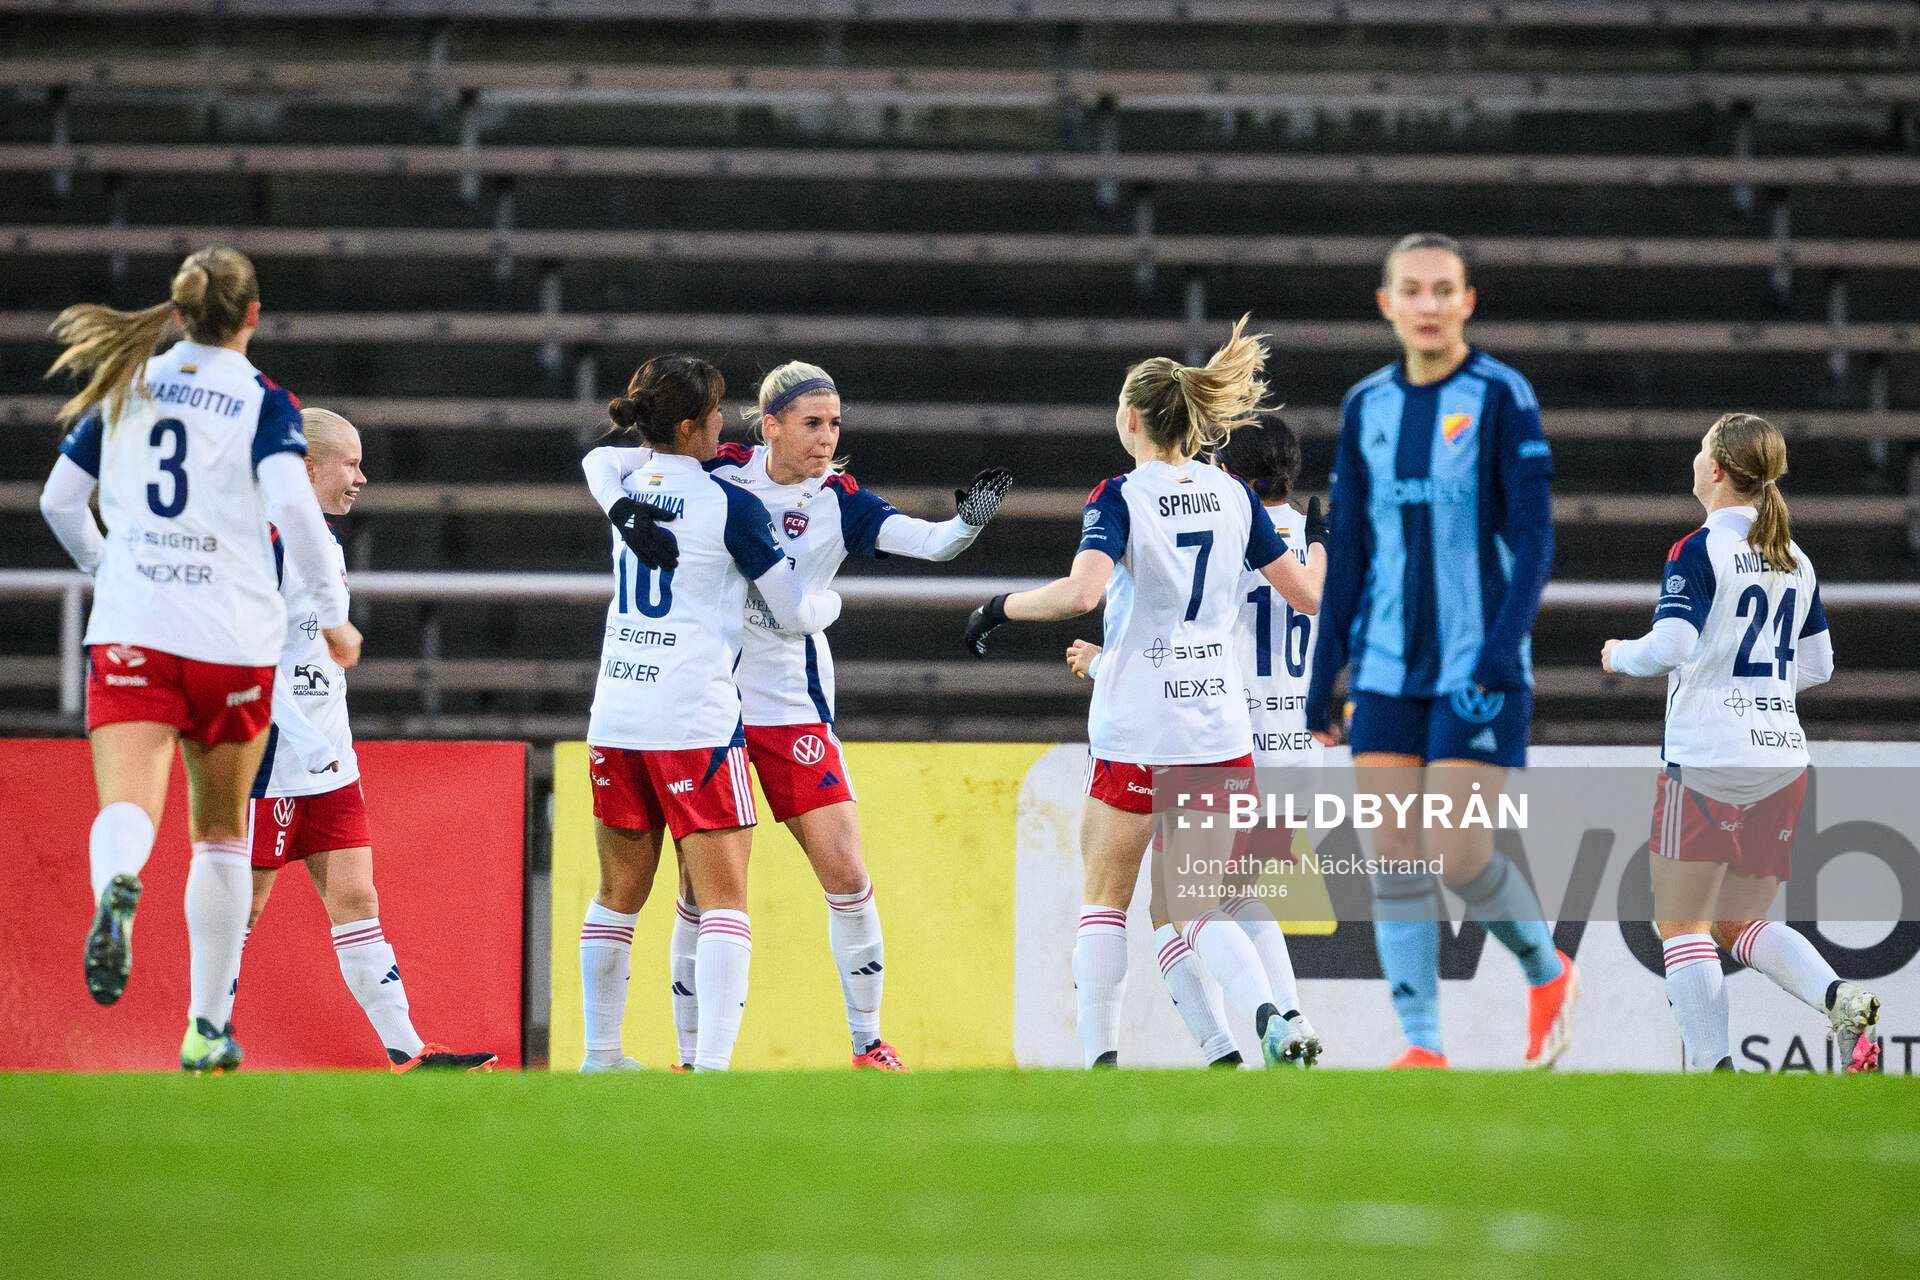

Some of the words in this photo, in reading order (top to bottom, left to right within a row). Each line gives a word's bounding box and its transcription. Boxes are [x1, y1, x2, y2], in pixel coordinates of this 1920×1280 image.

[147, 418, 188, 518] 3
[786, 517, 806, 528] FCR
[1158, 492, 1221, 517] SPRUNG
[1176, 529, 1214, 622] 7
[1247, 585, 1311, 677] 16
[1732, 583, 1797, 681] 24
[275, 831, 286, 856] 5
[1740, 1034, 1920, 1074] SAIT
